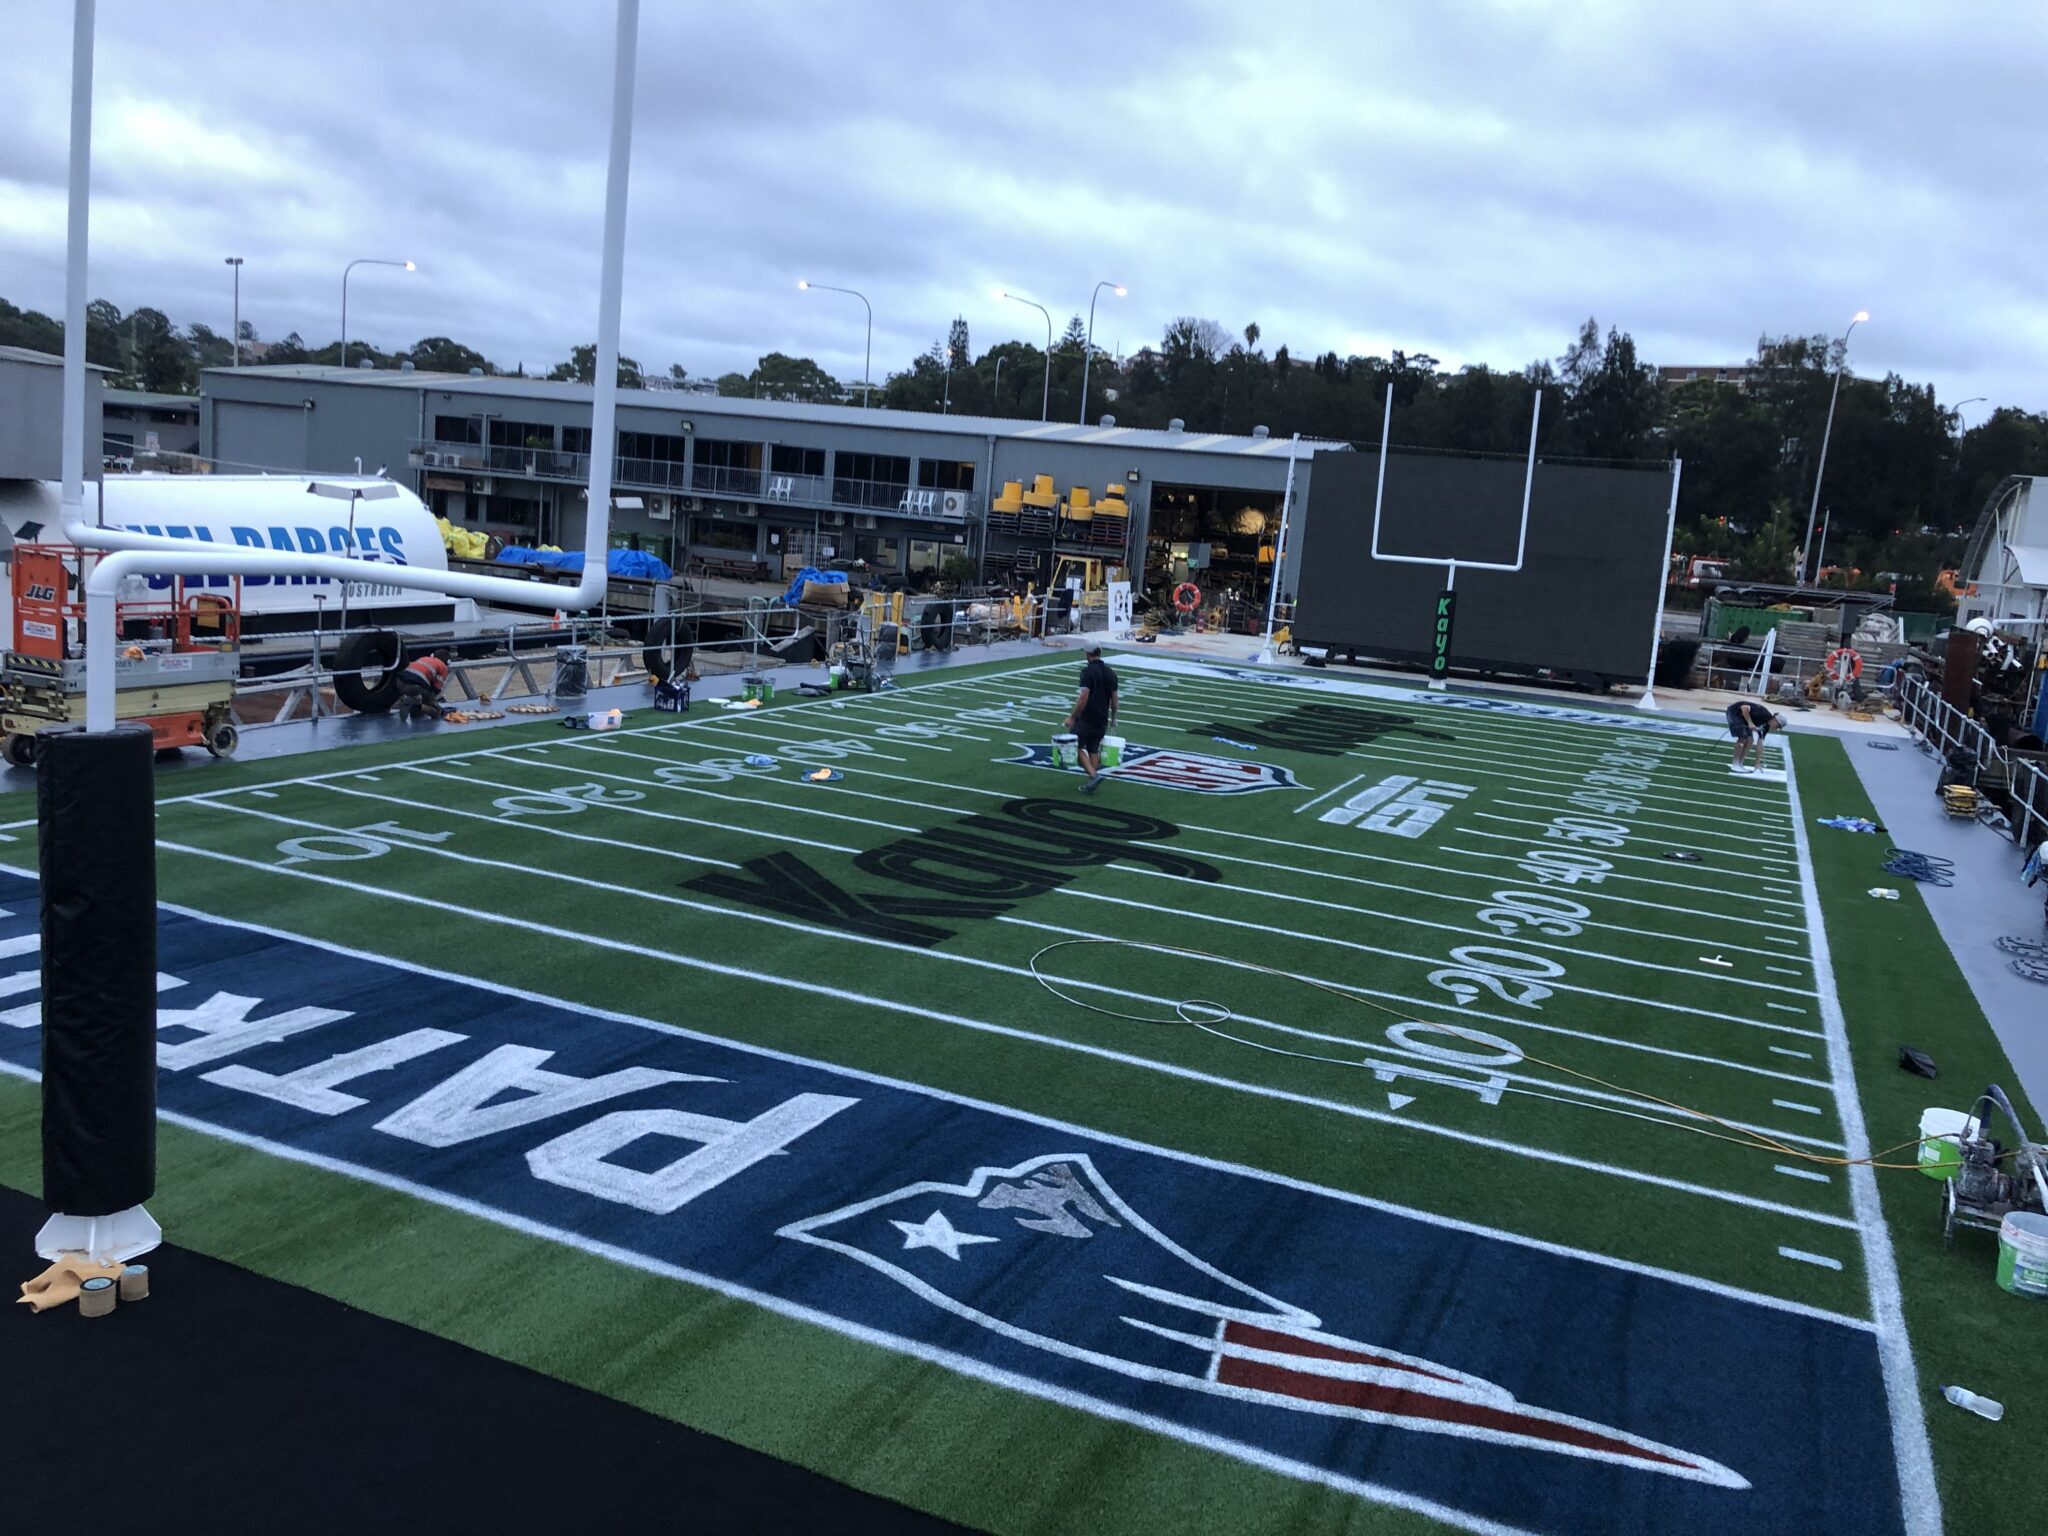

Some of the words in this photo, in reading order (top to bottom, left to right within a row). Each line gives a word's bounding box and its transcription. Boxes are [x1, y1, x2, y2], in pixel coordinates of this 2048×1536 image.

[26, 584, 56, 600] JLG
[1434, 598, 1452, 671] Kayo
[777, 739, 874, 758] 40
[654, 759, 782, 783] 30
[492, 782, 647, 815] 20
[1567, 791, 1643, 813] 40
[276, 821, 455, 861] 10
[1543, 817, 1630, 847] 50
[676, 799, 1221, 948] Kayo
[1517, 850, 1614, 884] 40
[1476, 890, 1592, 936] 30
[1426, 946, 1566, 1009] 20
[1363, 1022, 1526, 1105] 10
